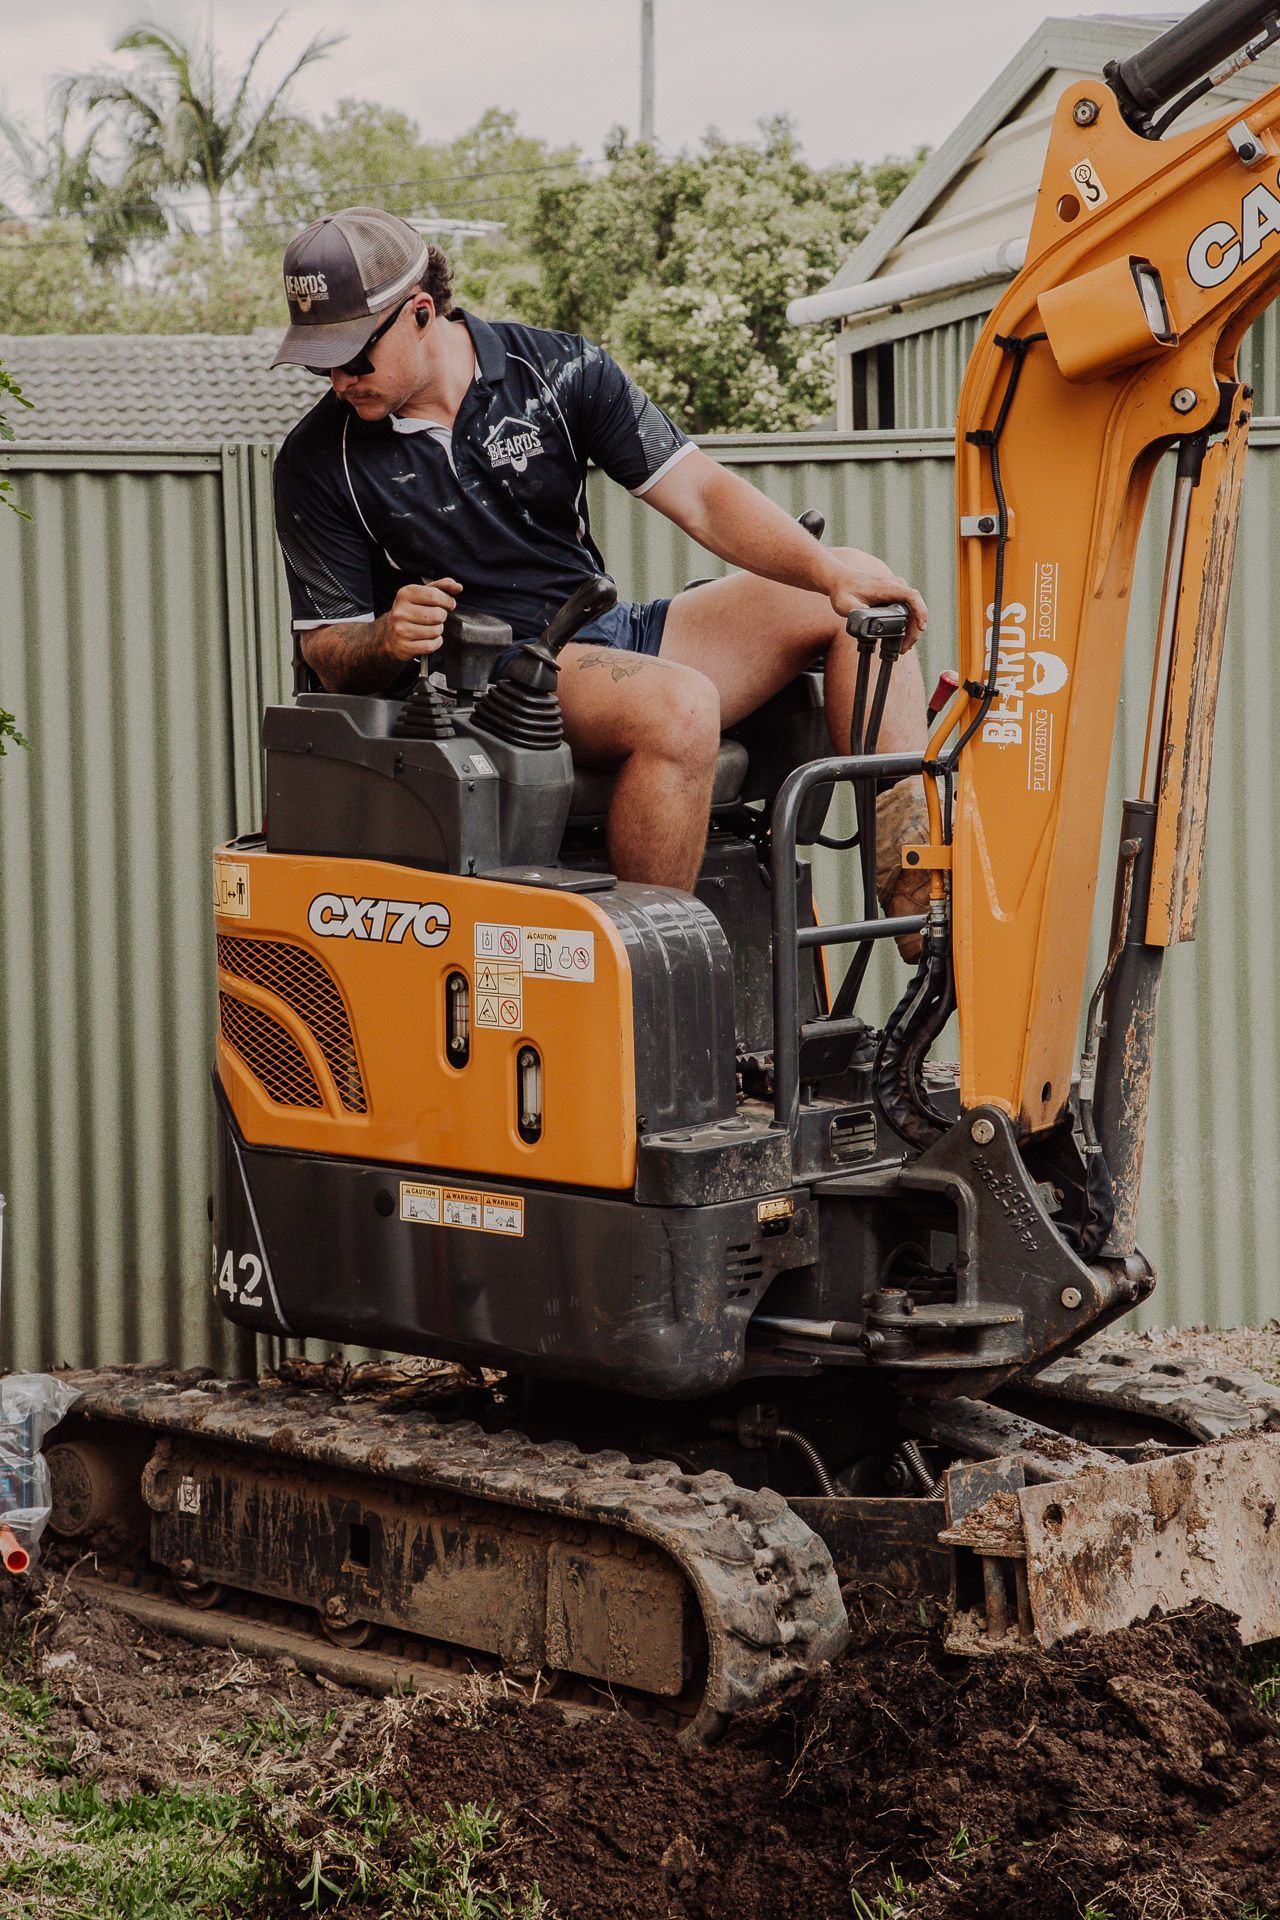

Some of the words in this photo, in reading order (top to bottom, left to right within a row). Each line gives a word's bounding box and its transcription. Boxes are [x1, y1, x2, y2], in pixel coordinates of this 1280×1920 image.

[1187, 168, 1280, 288] CA
[487, 430, 541, 461] BEARDS
[1038, 562, 1054, 639] ROOFING
[982, 601, 1027, 745] BEARDS
[1033, 707, 1049, 792] PLUMBING
[307, 892, 451, 948] CX17C
[533, 932, 557, 941] CAUTION
[411, 1187, 436, 1197] CAUTION
[452, 1193, 478, 1202] WARNING
[492, 1199, 519, 1208] WARNING
[212, 1244, 263, 1307] 42
